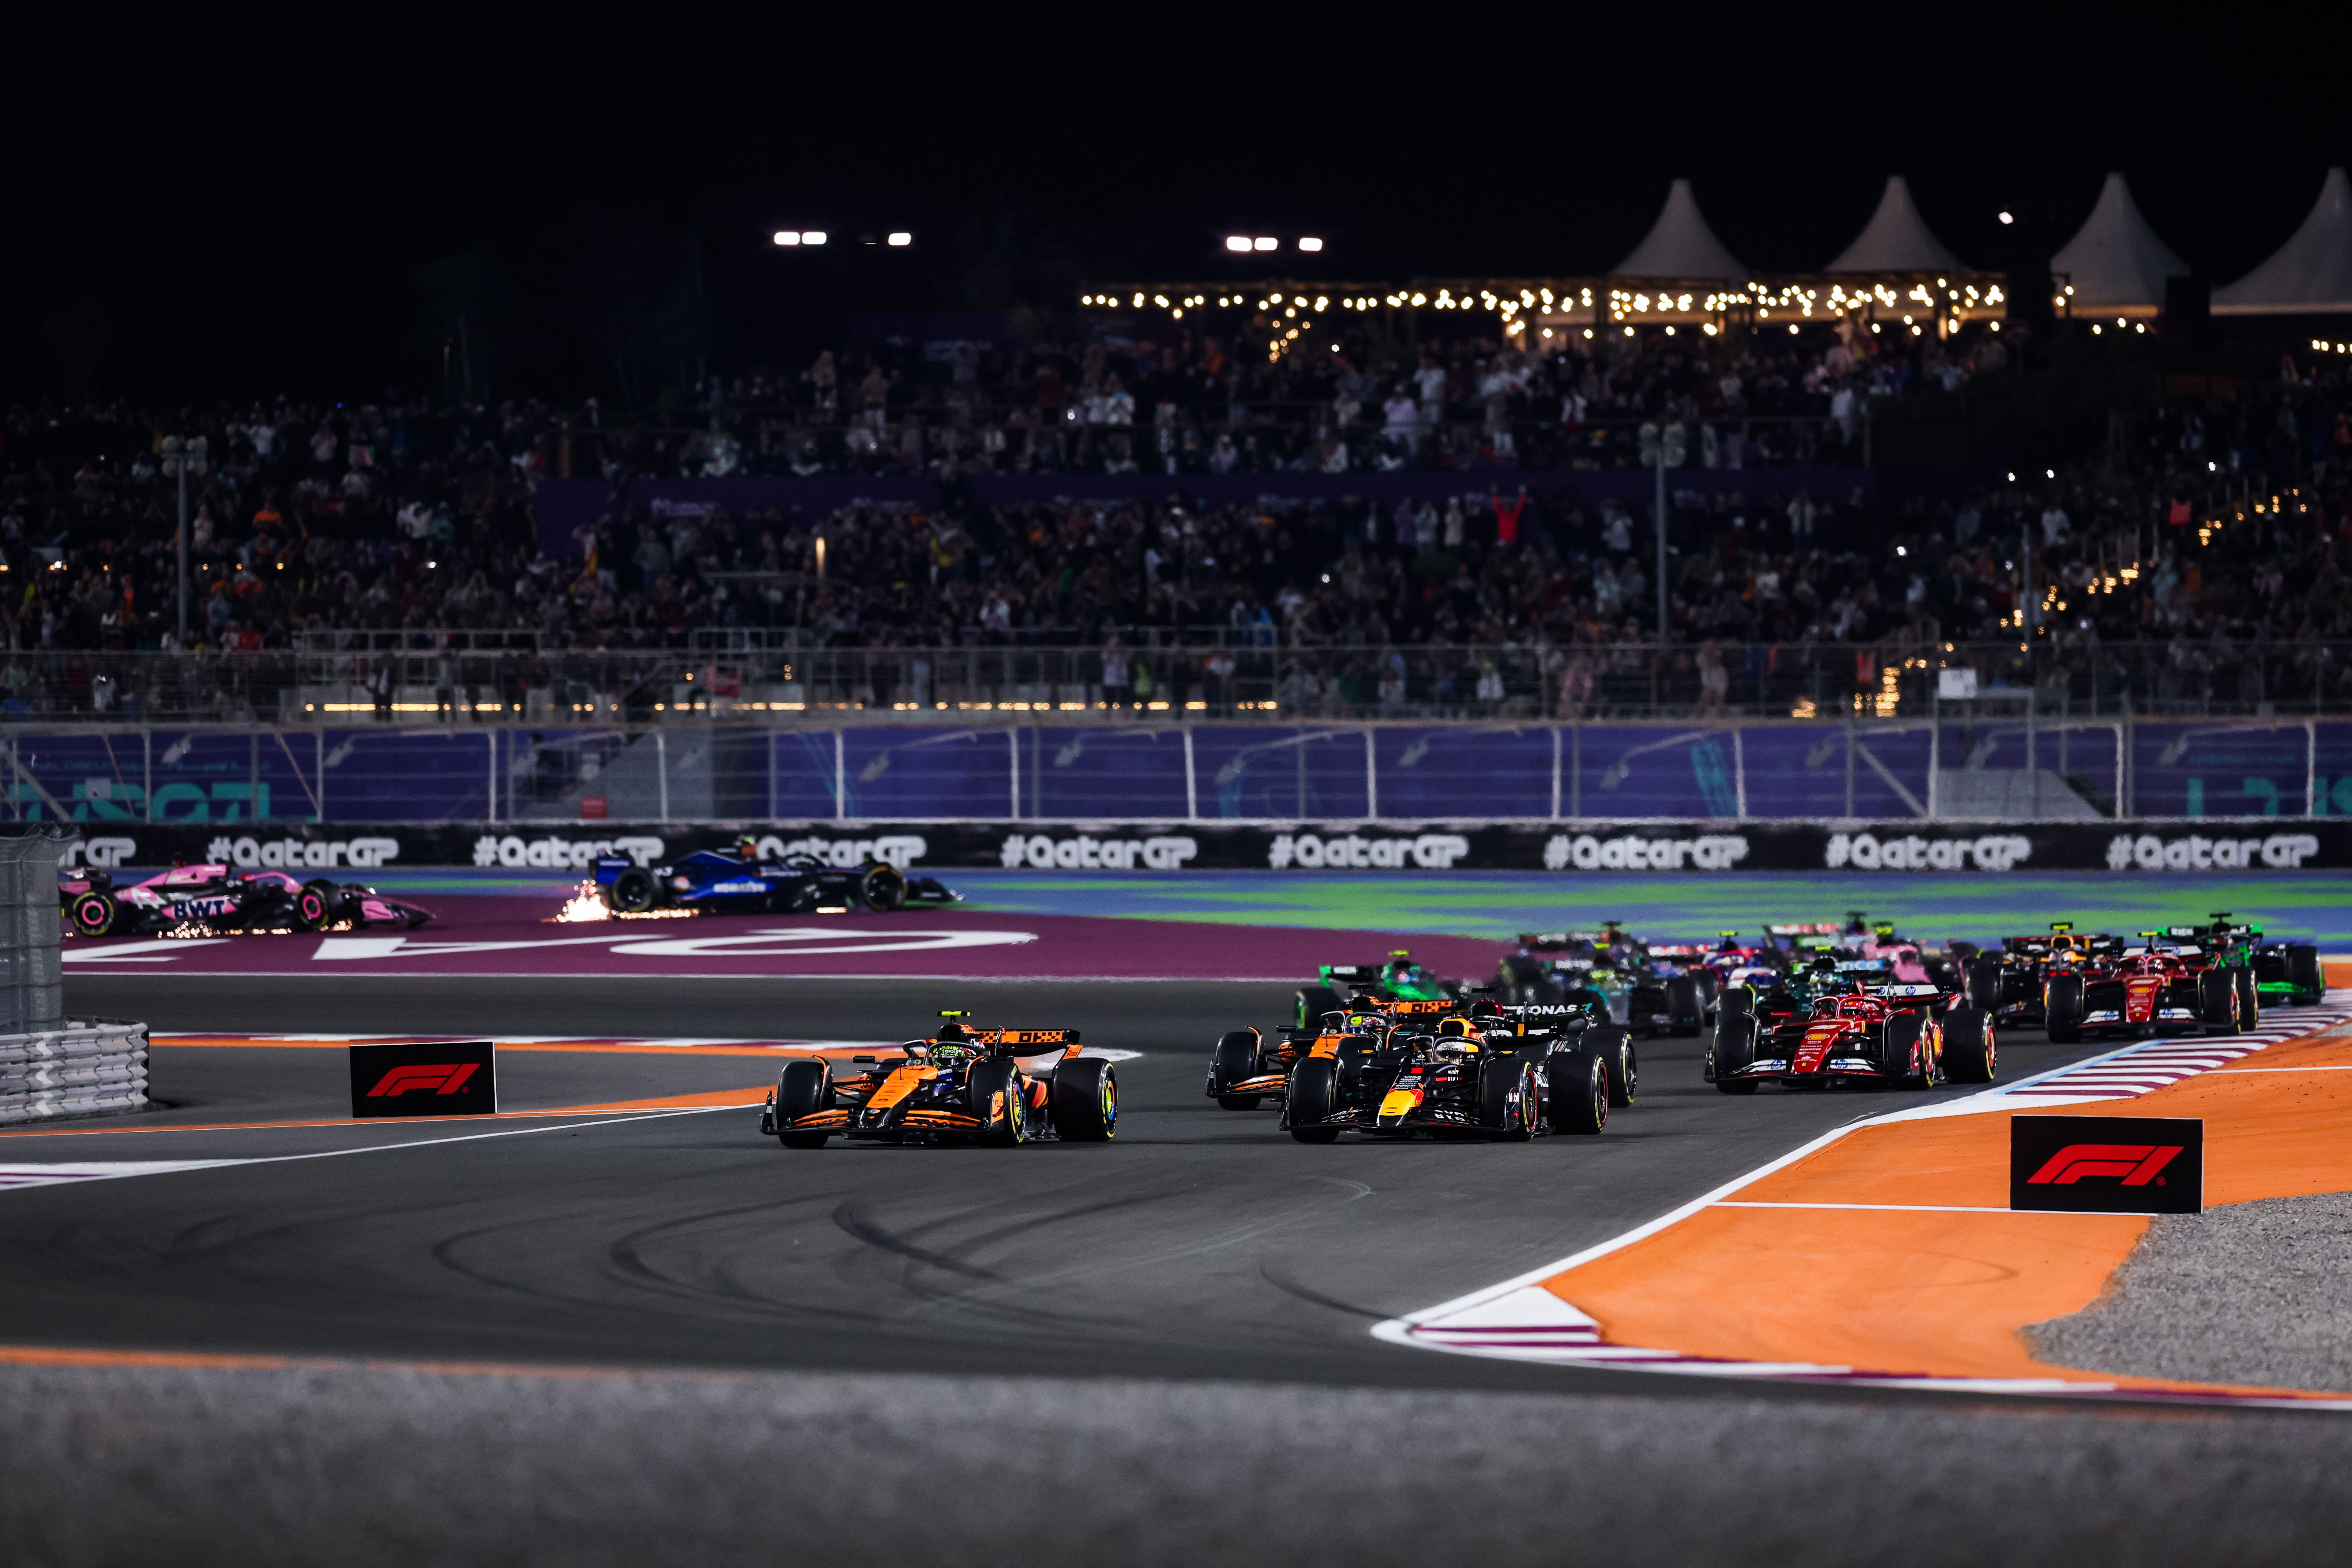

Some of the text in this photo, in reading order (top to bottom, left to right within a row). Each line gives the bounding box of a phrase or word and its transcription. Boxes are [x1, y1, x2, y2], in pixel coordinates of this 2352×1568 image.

[207, 837, 398, 867] #QatarGP
[1000, 835, 1198, 869] #QatarGP
[1268, 835, 1469, 869] #QatarGP
[1544, 835, 1749, 869] #QatarGP
[1825, 834, 2033, 871] #QatarGP
[2106, 834, 2318, 869] #QatarGP
[174, 900, 225, 917] BWT
[366, 1063, 481, 1096] F1
[2027, 1144, 2185, 1185] F1
